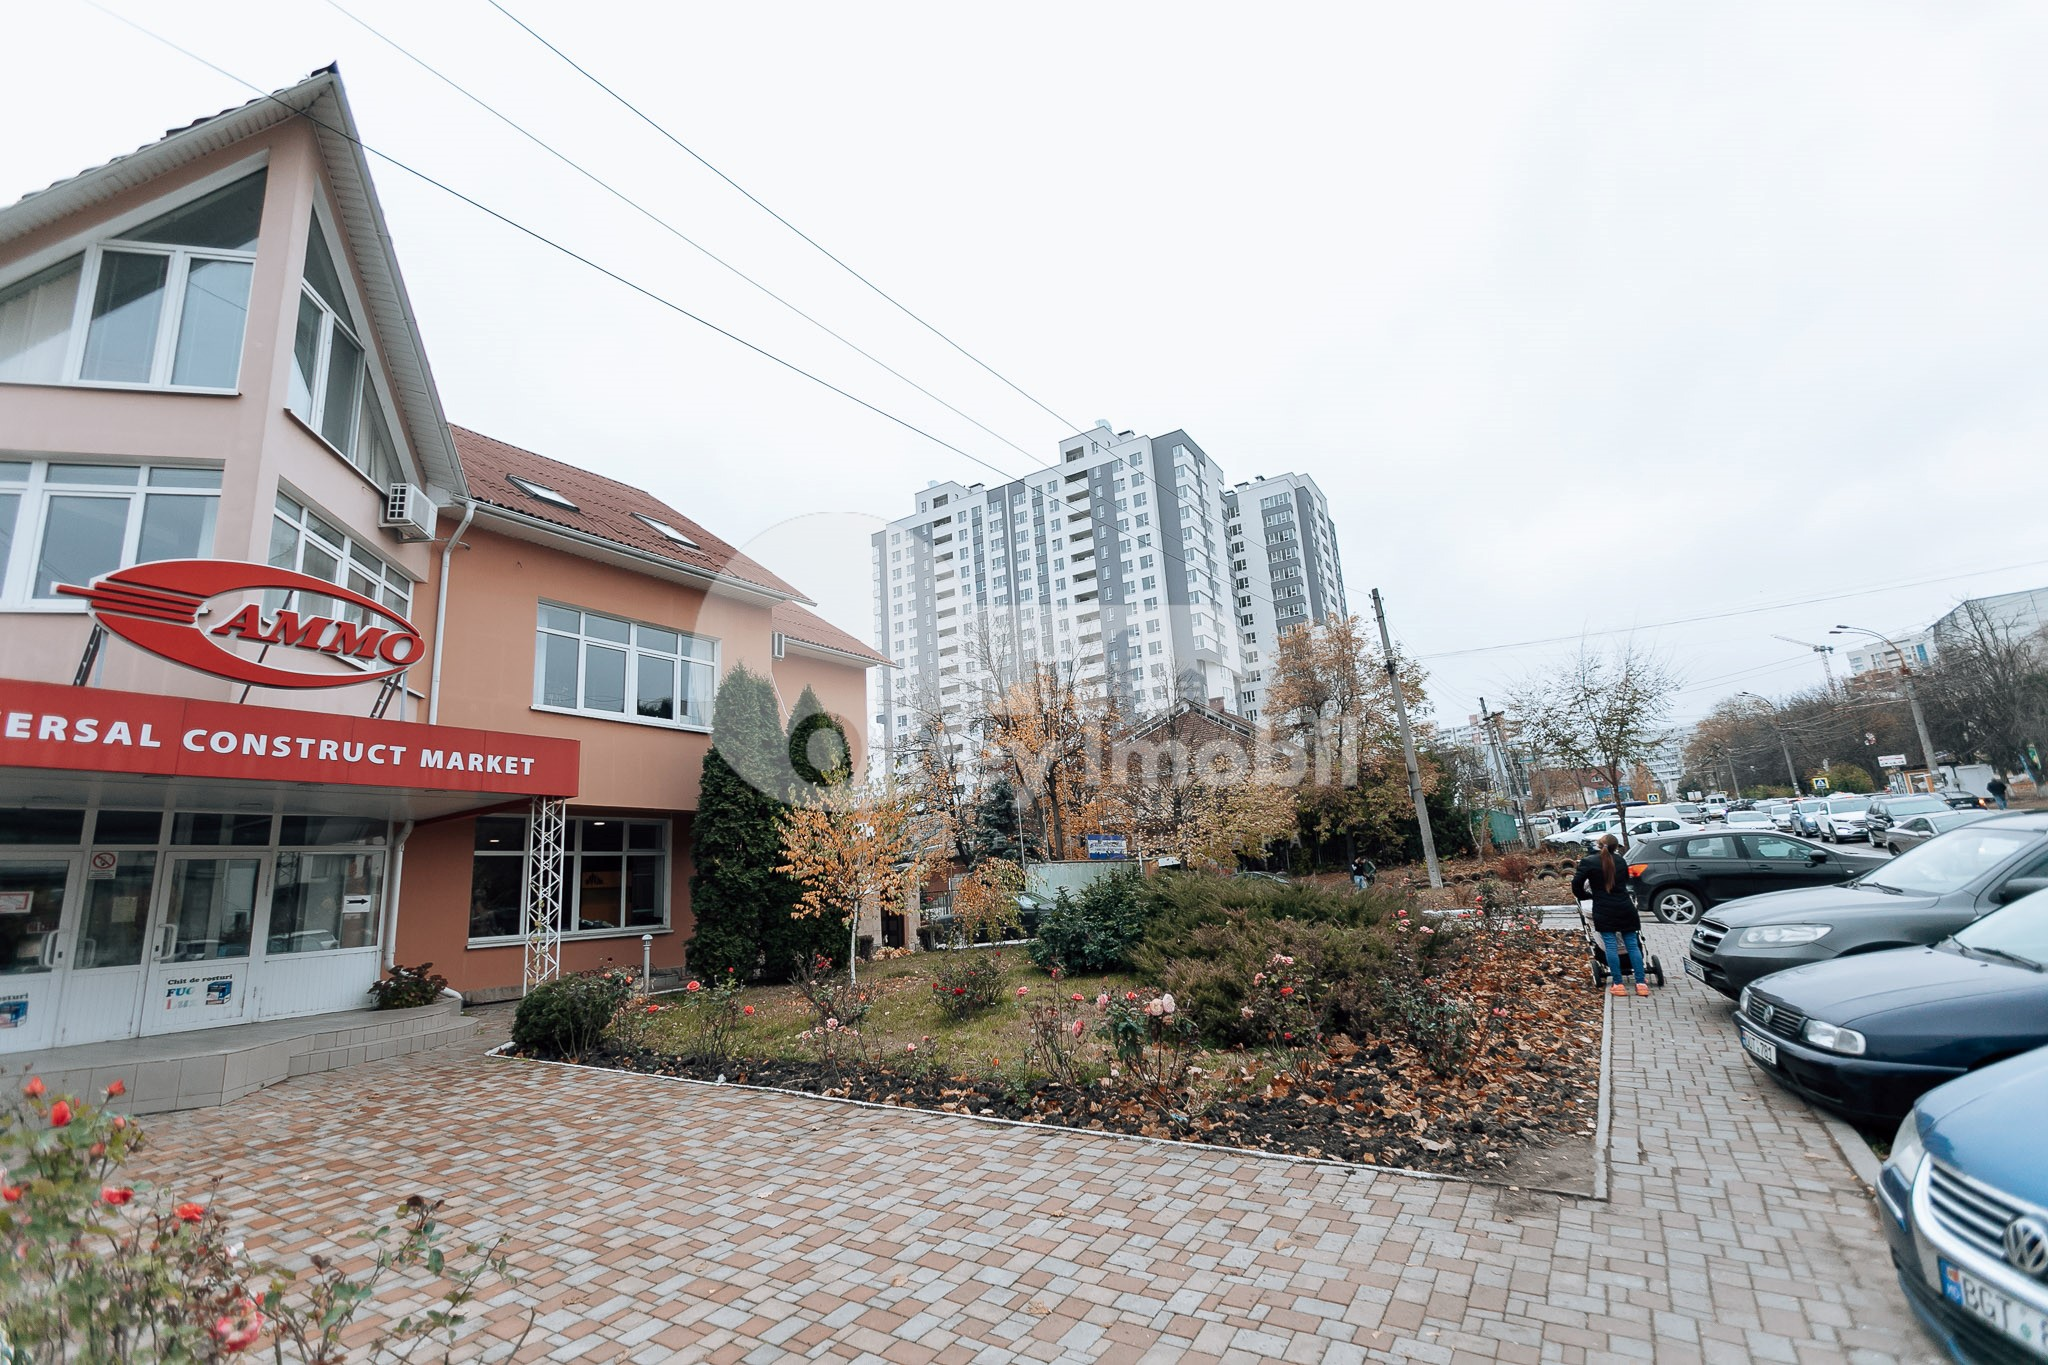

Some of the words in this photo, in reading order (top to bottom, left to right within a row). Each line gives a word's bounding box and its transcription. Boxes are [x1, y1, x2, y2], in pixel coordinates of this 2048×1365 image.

[210, 603, 426, 664] AMMO
[0, 711, 161, 748] ERSAL
[182, 728, 407, 766] CONSTRUCT
[419, 748, 536, 776] MARKET
[167, 978, 187, 986] Chit
[202, 973, 233, 983] rosturi
[1962, 1276, 2012, 1330] BGT
